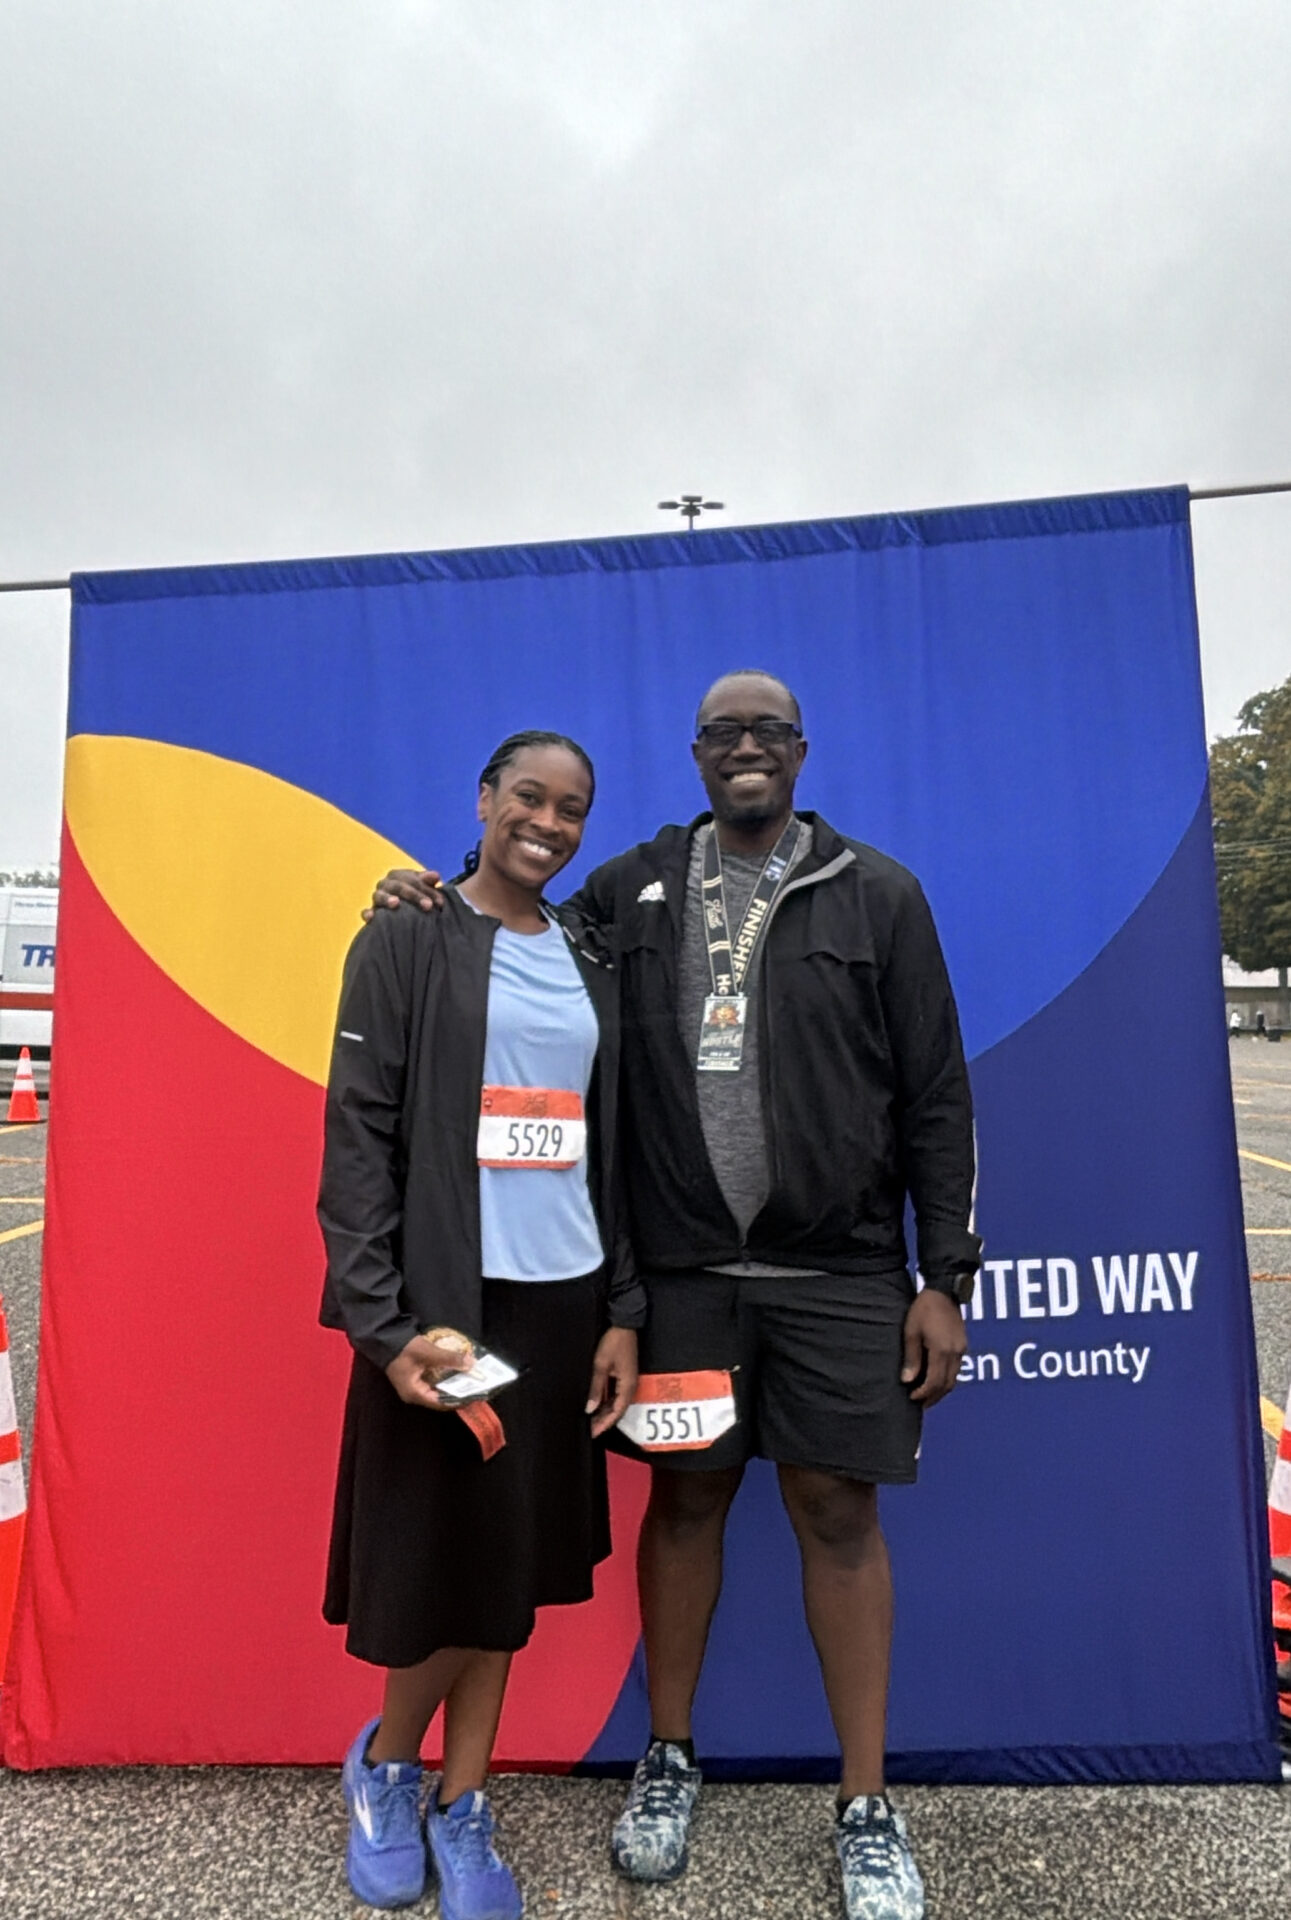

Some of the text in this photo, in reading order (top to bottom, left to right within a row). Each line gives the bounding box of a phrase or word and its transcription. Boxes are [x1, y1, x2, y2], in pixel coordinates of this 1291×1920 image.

[507, 1123, 563, 1158] 5529
[916, 1251, 1199, 1321] ITED WAY
[1014, 1342, 1151, 1383] County
[646, 1406, 704, 1441] 5551
